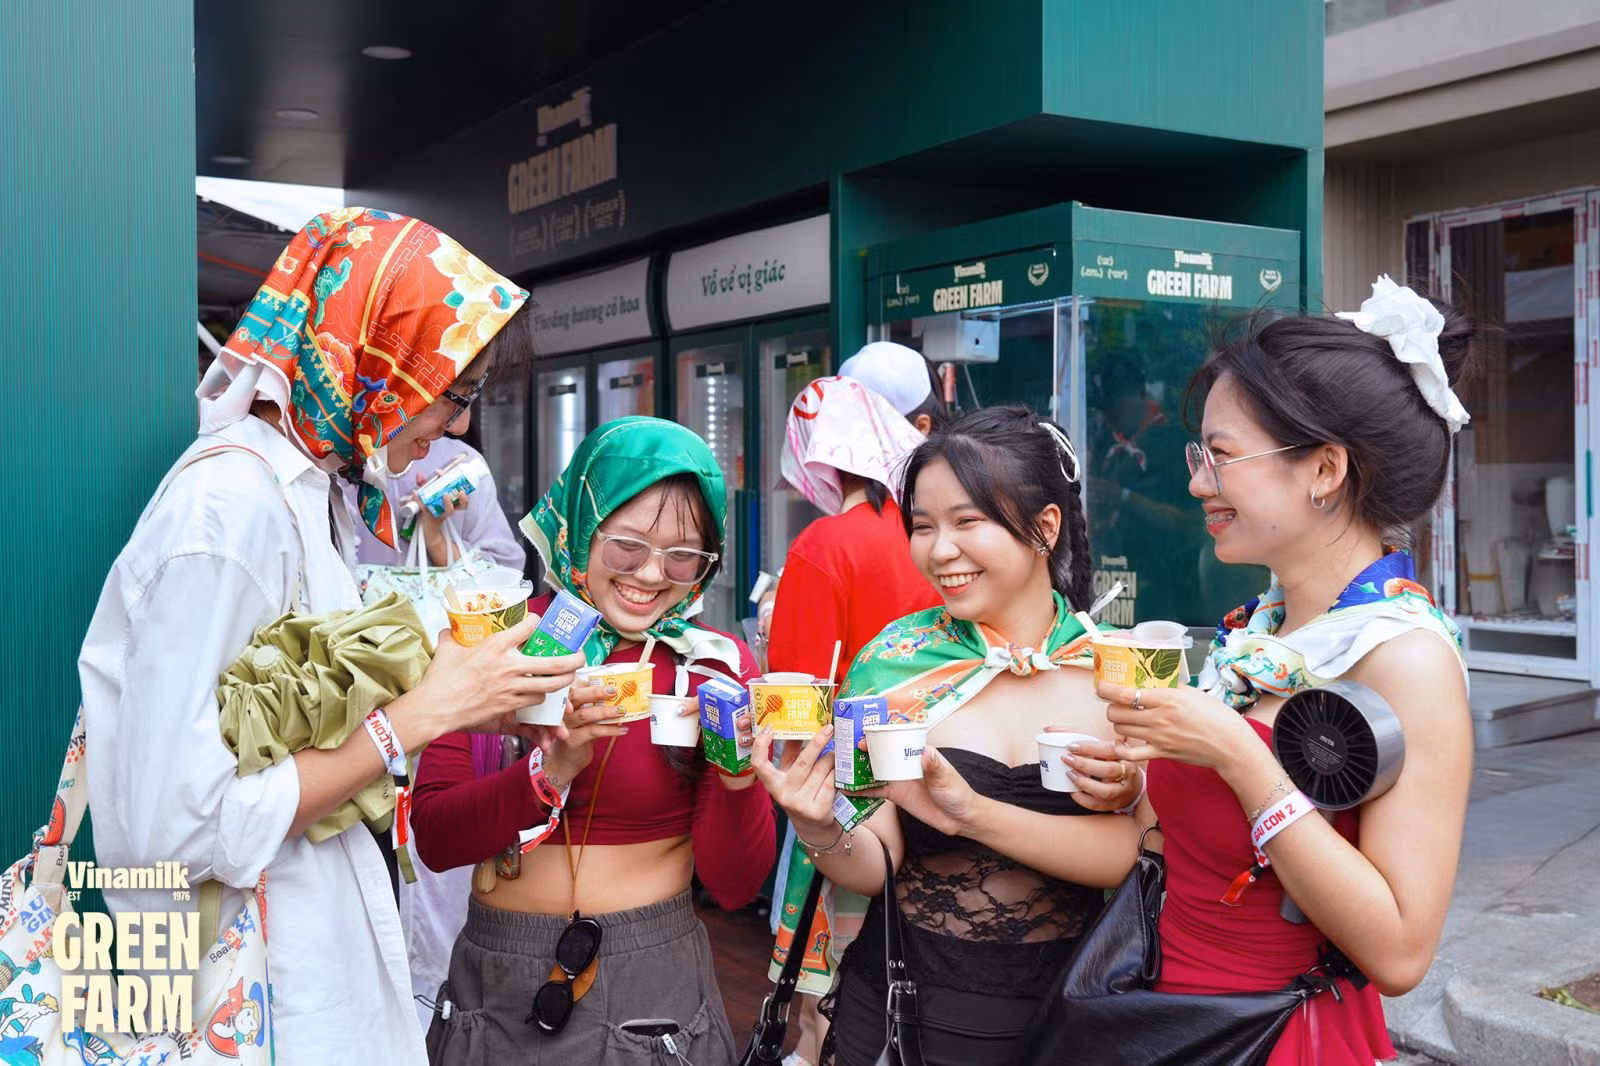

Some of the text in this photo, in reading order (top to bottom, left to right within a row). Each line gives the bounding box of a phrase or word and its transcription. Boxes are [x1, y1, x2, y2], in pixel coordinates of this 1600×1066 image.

[755, 259, 785, 292] giác
[1147, 269, 1191, 297] GREEN
[1194, 272, 1232, 300] FARM
[933, 284, 968, 312] GREEN
[969, 280, 1003, 307] FARM
[1093, 570, 1137, 598] GREEN
[371, 720, 391, 743] CON
[1263, 809, 1287, 831] CON
[1285, 803, 1296, 816] 2
